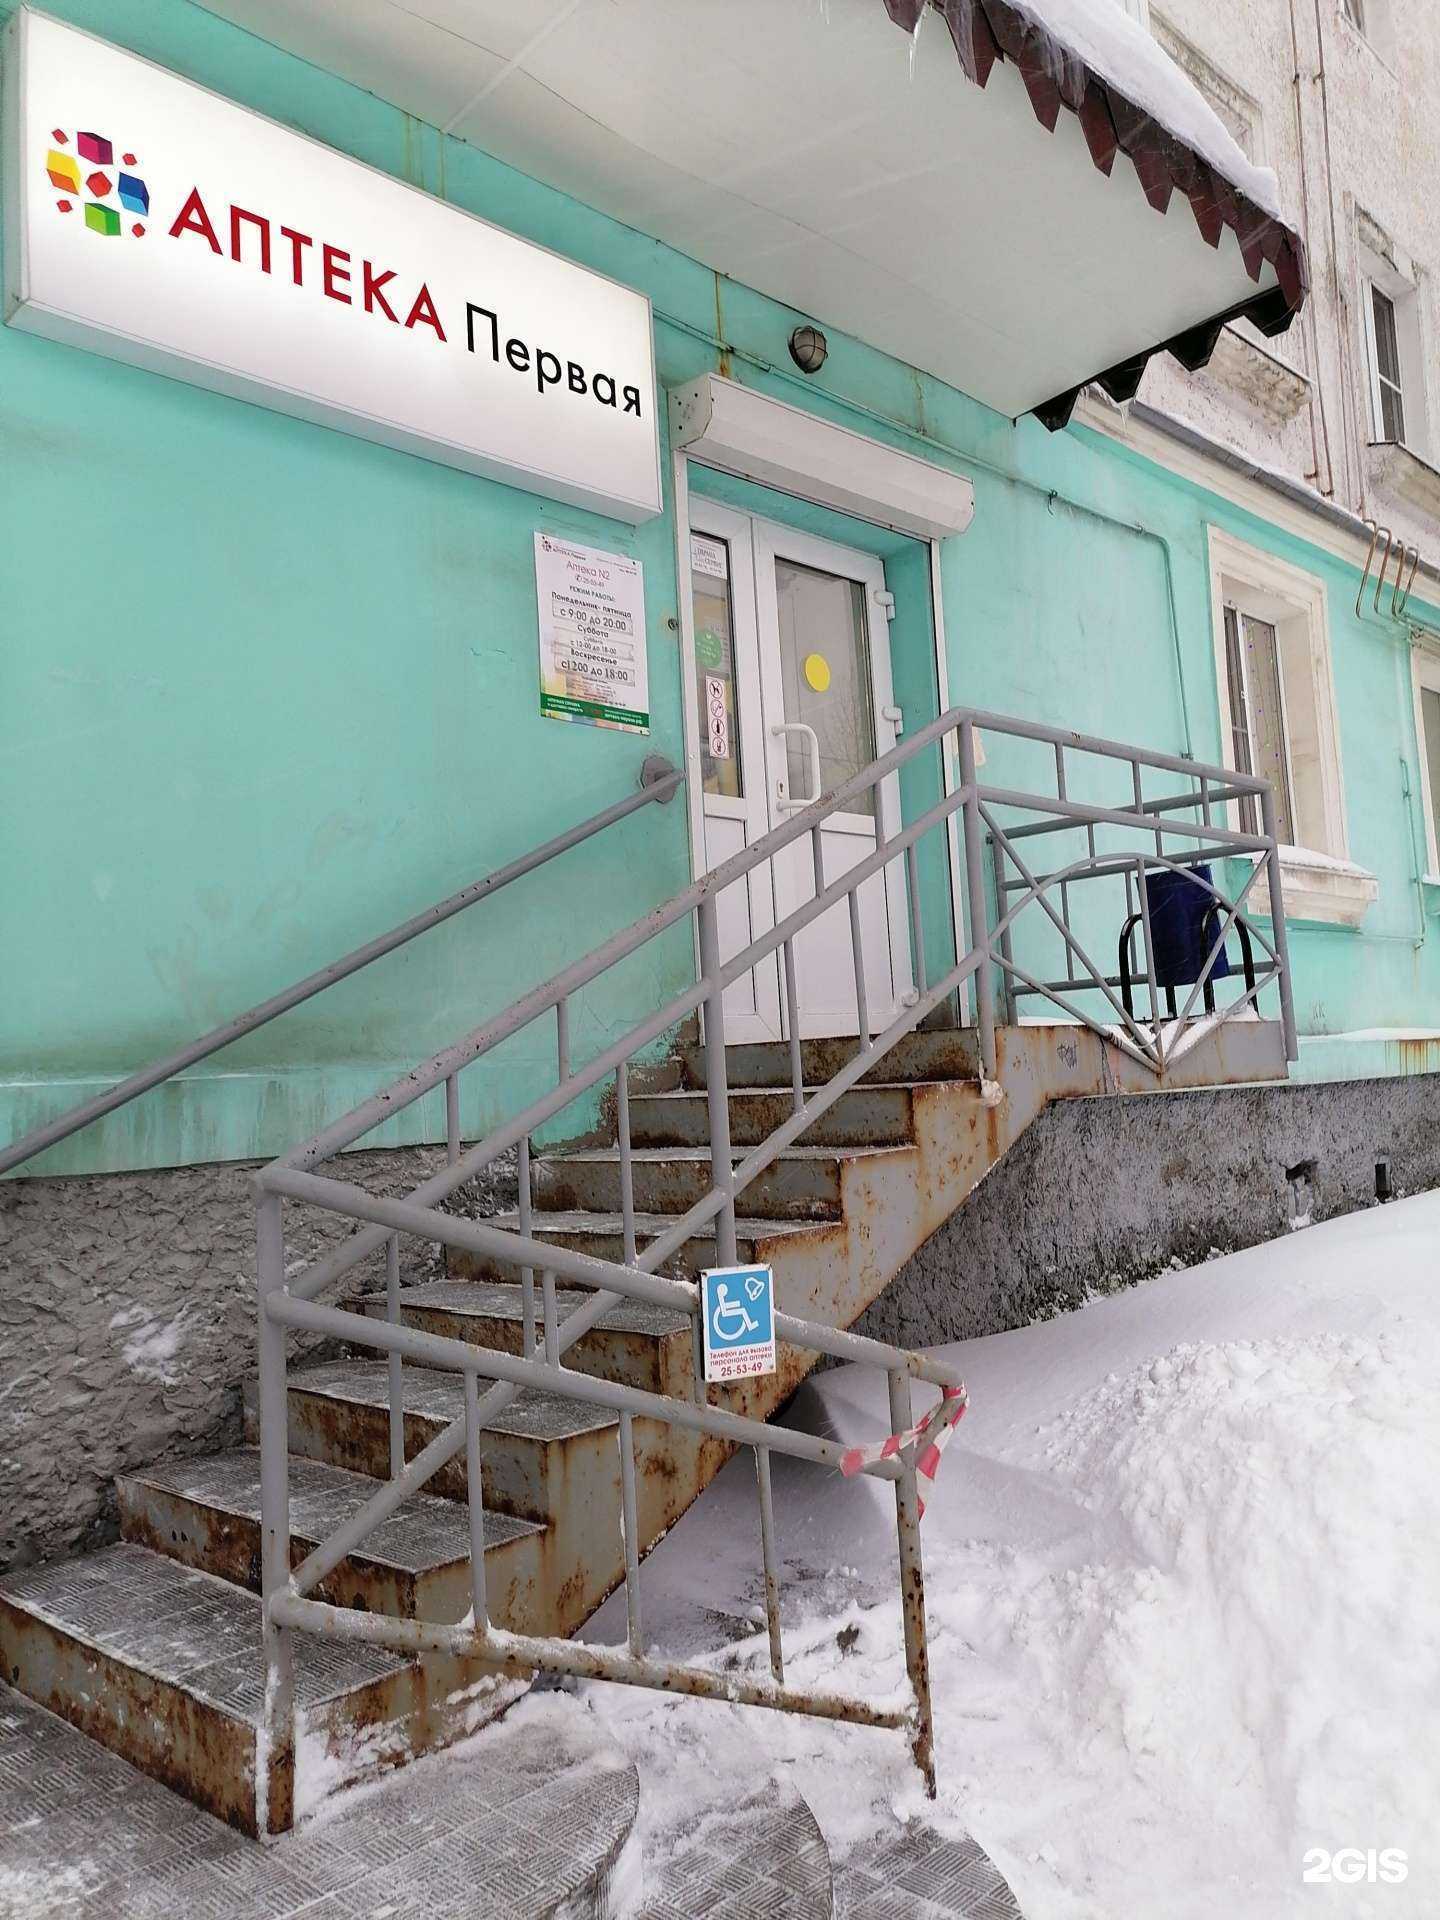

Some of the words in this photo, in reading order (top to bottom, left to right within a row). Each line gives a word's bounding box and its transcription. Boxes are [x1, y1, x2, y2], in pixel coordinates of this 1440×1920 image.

[168, 187, 447, 343] АПТЕКА
[466, 302, 642, 417] Первая
[567, 561, 597, 576] Аптека
[589, 616, 601, 625] до
[577, 624, 609, 638] Суббота
[570, 648, 618, 665] Воскресенье
[590, 667, 603, 676] до
[710, 1351, 737, 1359] Телефон
[710, 1356, 748, 1366] персонала
[720, 1362, 763, 1377] 25-53-49
